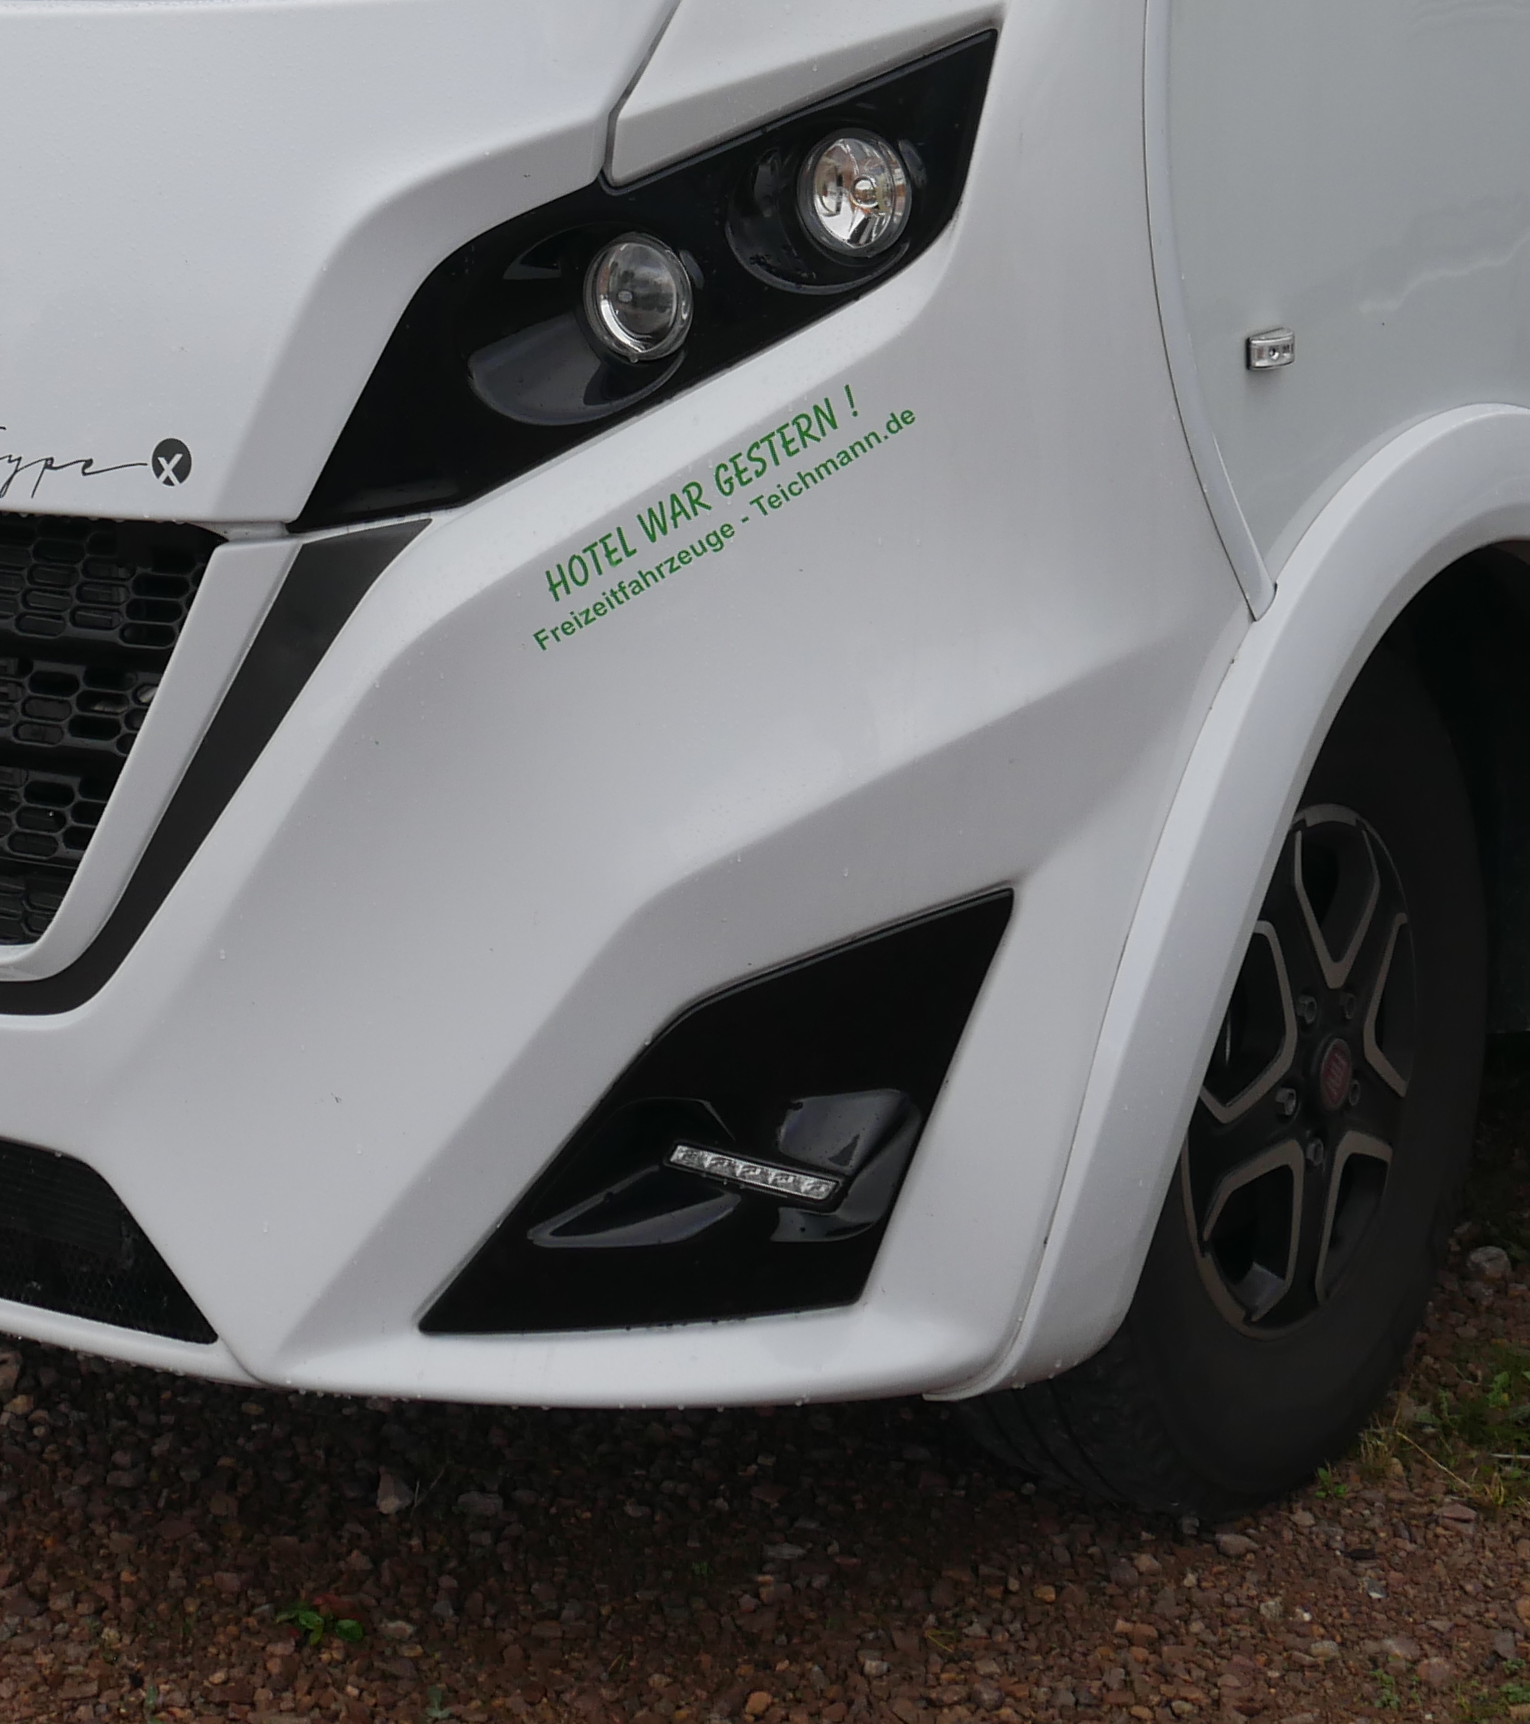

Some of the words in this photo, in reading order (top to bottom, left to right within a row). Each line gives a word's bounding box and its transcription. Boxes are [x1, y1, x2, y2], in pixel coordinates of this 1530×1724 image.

[532, 521, 736, 652] Freizeitfahrzeuge
[749, 408, 917, 518] Teichmann.de
[544, 525, 638, 602] HOTEL
[635, 480, 712, 543] WAR
[714, 396, 839, 497] GESTERN
